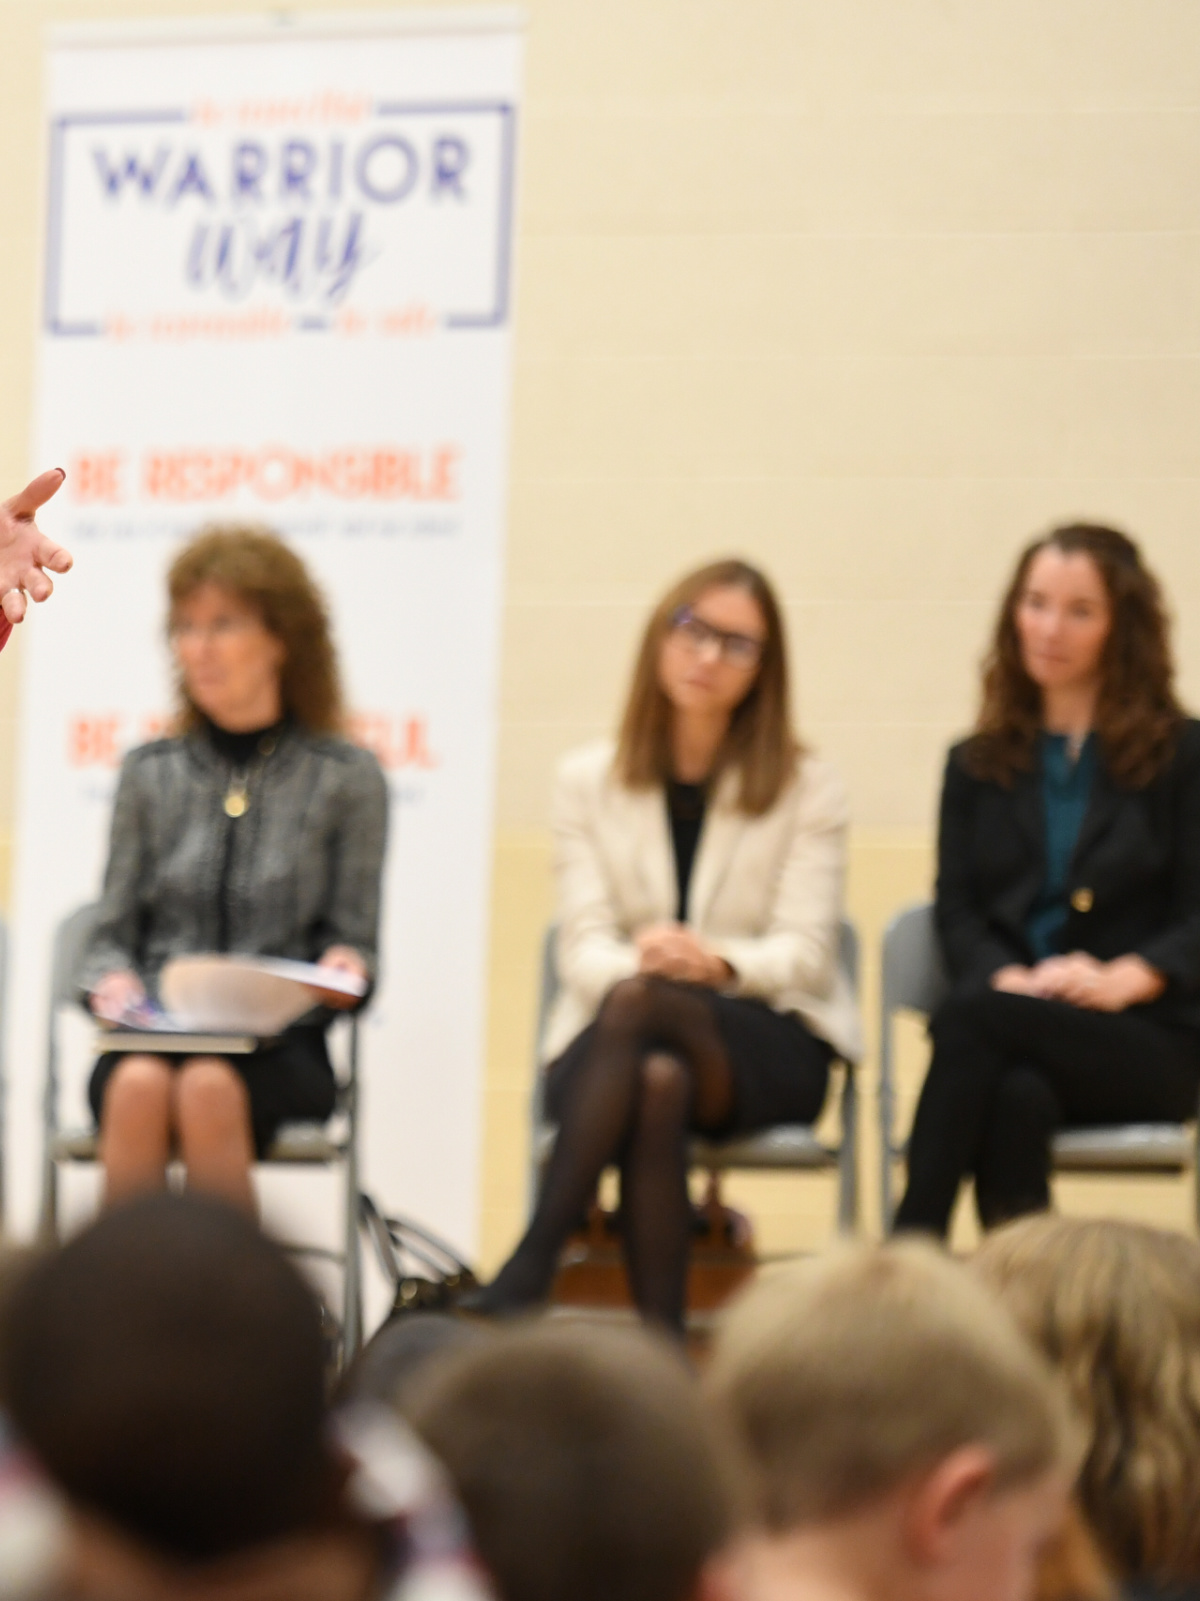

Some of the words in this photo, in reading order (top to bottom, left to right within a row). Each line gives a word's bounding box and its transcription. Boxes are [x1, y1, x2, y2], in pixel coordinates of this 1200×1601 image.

[93, 133, 469, 206] WARRIOR
[73, 449, 123, 503] BE
[143, 442, 463, 502] RESPONSIBLE
[71, 711, 122, 766] BE
